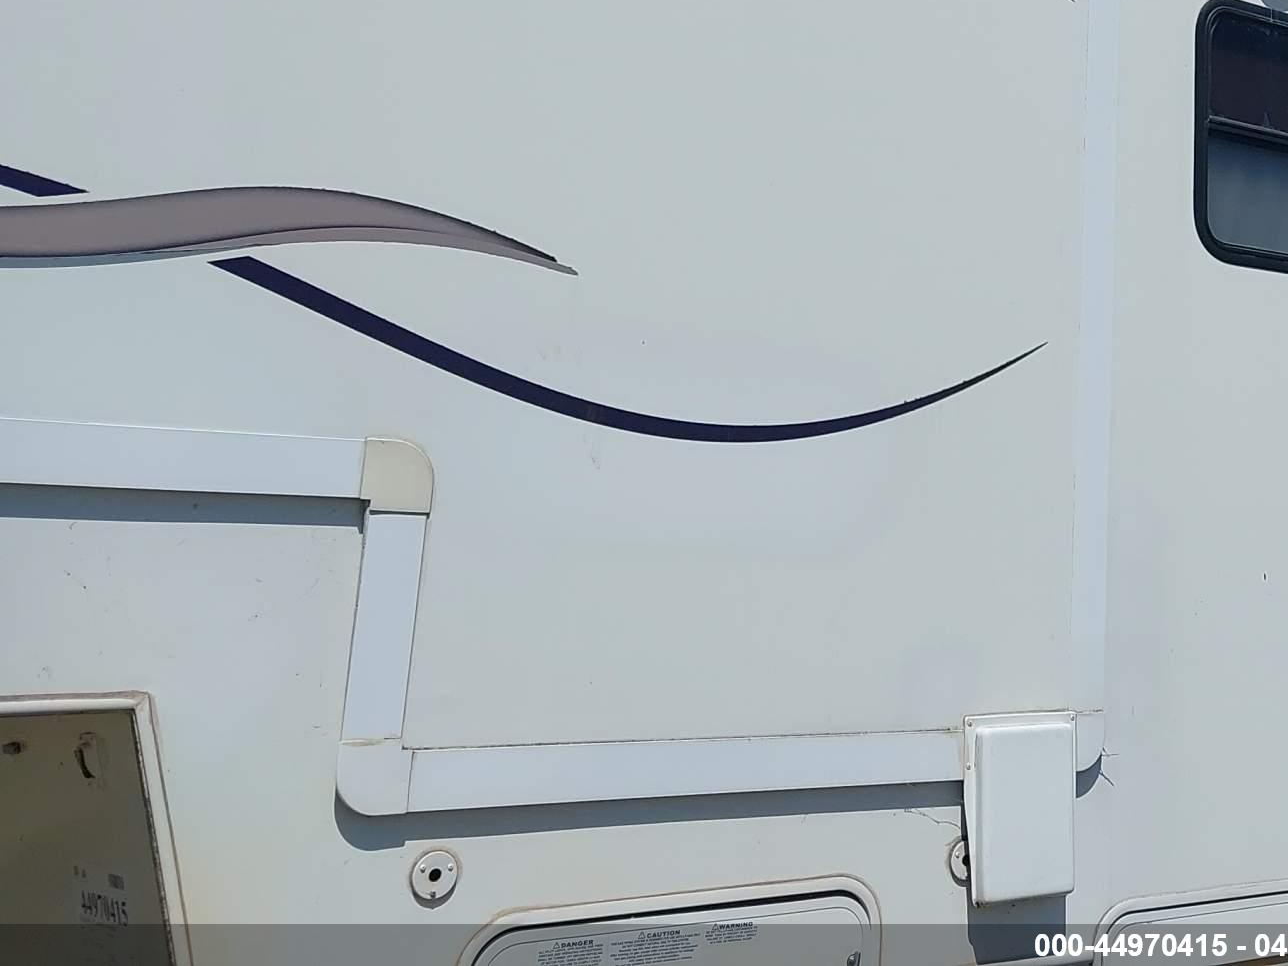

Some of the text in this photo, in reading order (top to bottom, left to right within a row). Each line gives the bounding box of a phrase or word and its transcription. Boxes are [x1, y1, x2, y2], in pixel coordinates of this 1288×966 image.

[720, 921, 754, 931] WARNING
[646, 930, 681, 940] CAUTION
[561, 939, 594, 949] DANGER
